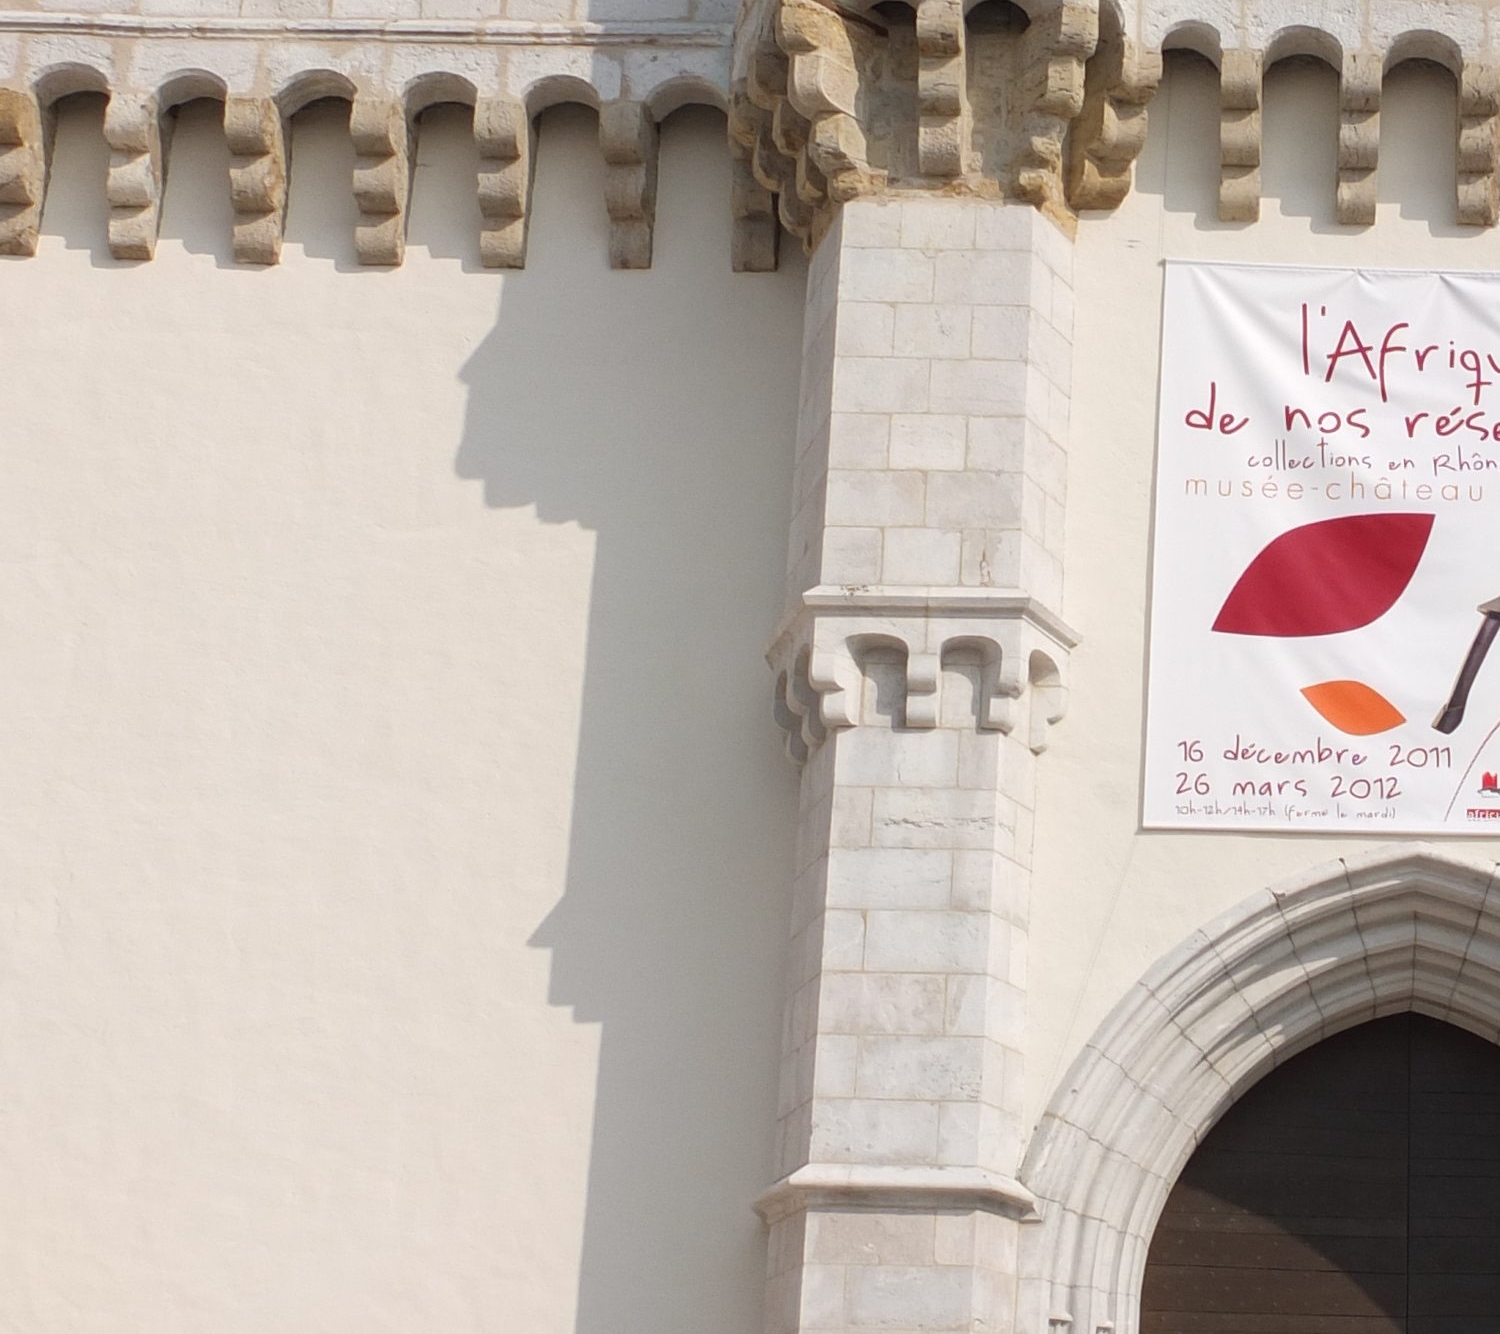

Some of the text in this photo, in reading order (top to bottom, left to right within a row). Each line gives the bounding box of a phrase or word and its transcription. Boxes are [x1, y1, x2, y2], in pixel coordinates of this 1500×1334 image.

[1184, 381, 1250, 435] de
[1284, 405, 1371, 439] nos
[1247, 437, 1373, 471] collections
[1387, 456, 1416, 471] en
[1184, 471, 1484, 502] musée-château
[1177, 734, 1452, 769] 16 décembre 2011
[1175, 772, 1402, 799] 26 mars 2012
[1337, 802, 1348, 819] le
[1356, 806, 1396, 819] mardi)
